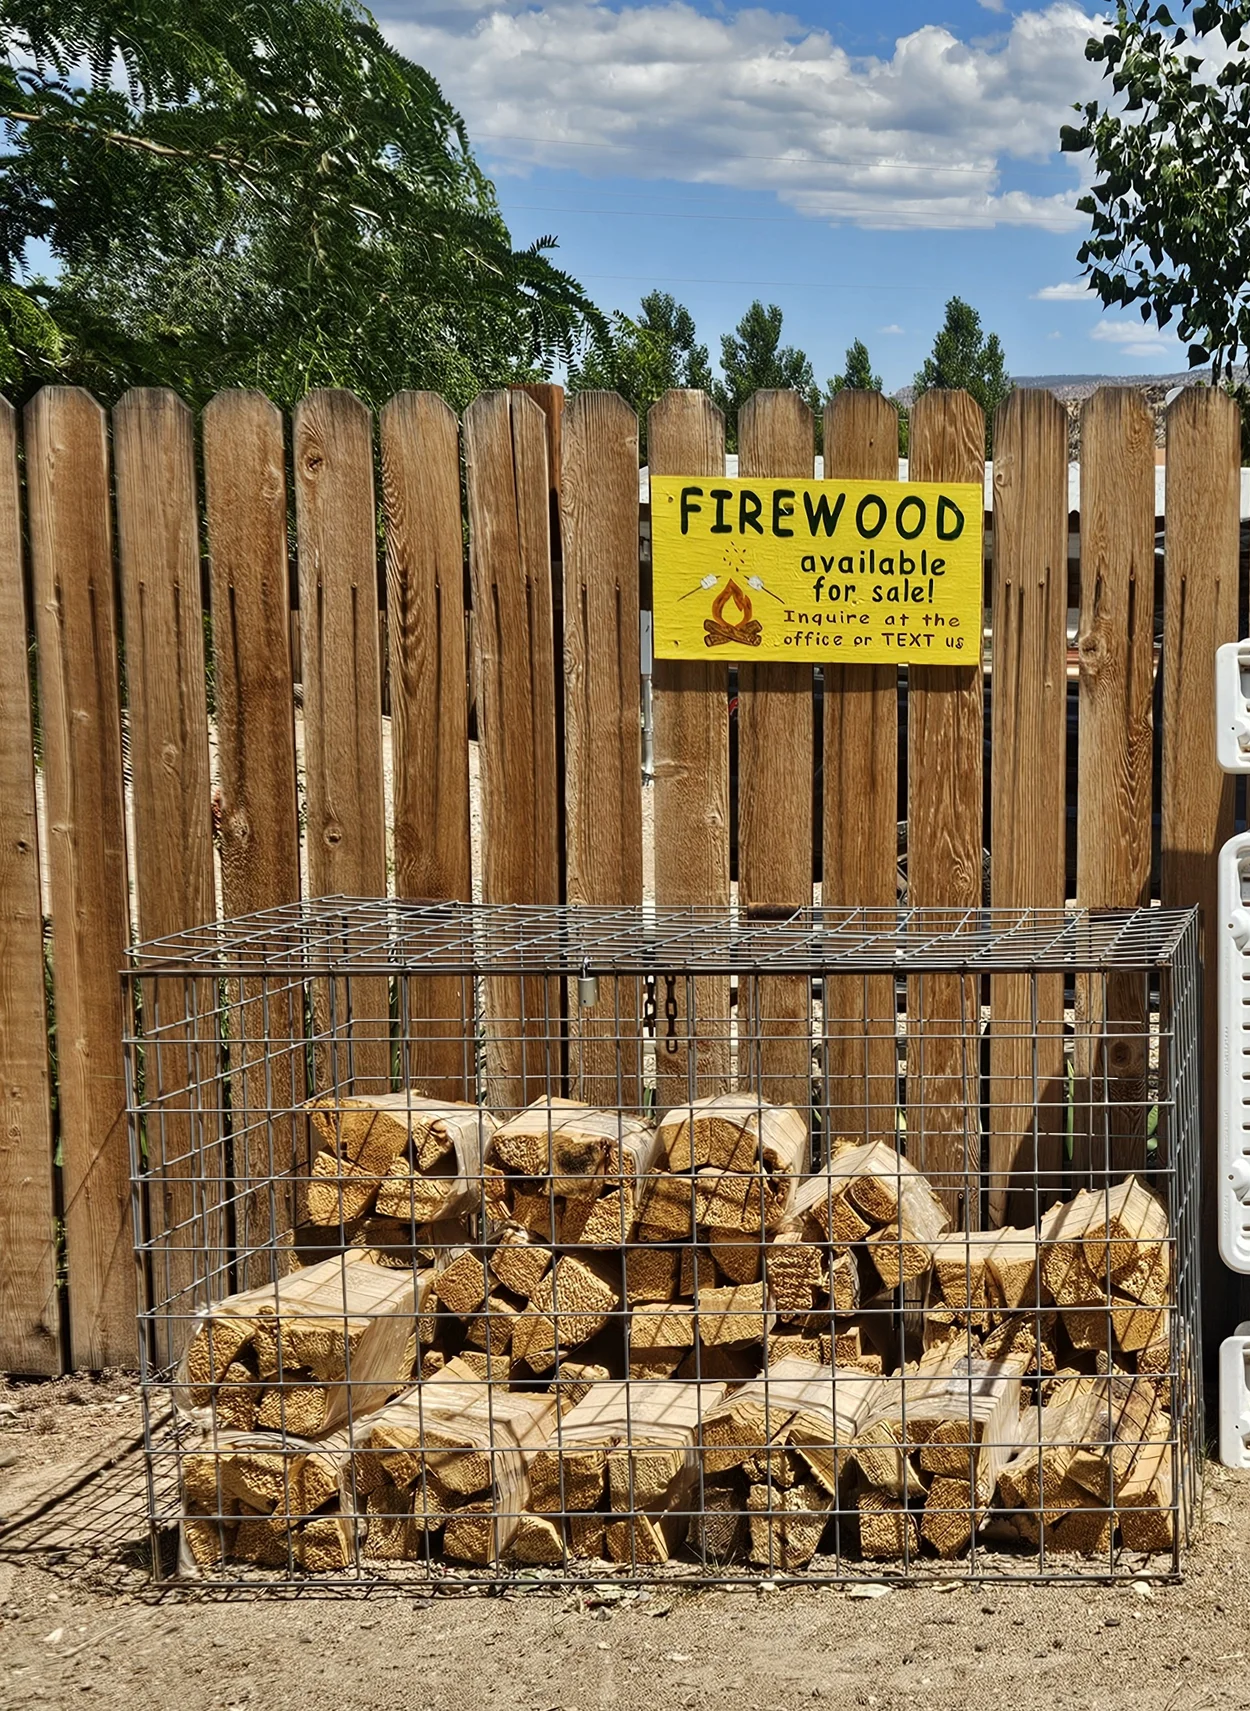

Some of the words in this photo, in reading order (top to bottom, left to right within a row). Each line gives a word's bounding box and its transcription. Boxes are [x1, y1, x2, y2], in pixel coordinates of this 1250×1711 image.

[680, 486, 966, 541] FIREWOOD
[800, 550, 946, 576] available
[813, 576, 857, 603] for
[871, 578, 934, 604] sale!
[783, 610, 870, 626] Inquire
[885, 614, 910, 626] at
[922, 611, 961, 628] the
[783, 631, 844, 647] office
[853, 635, 873, 648] or
[881, 632, 936, 648] TEXT
[945, 635, 965, 650] us
